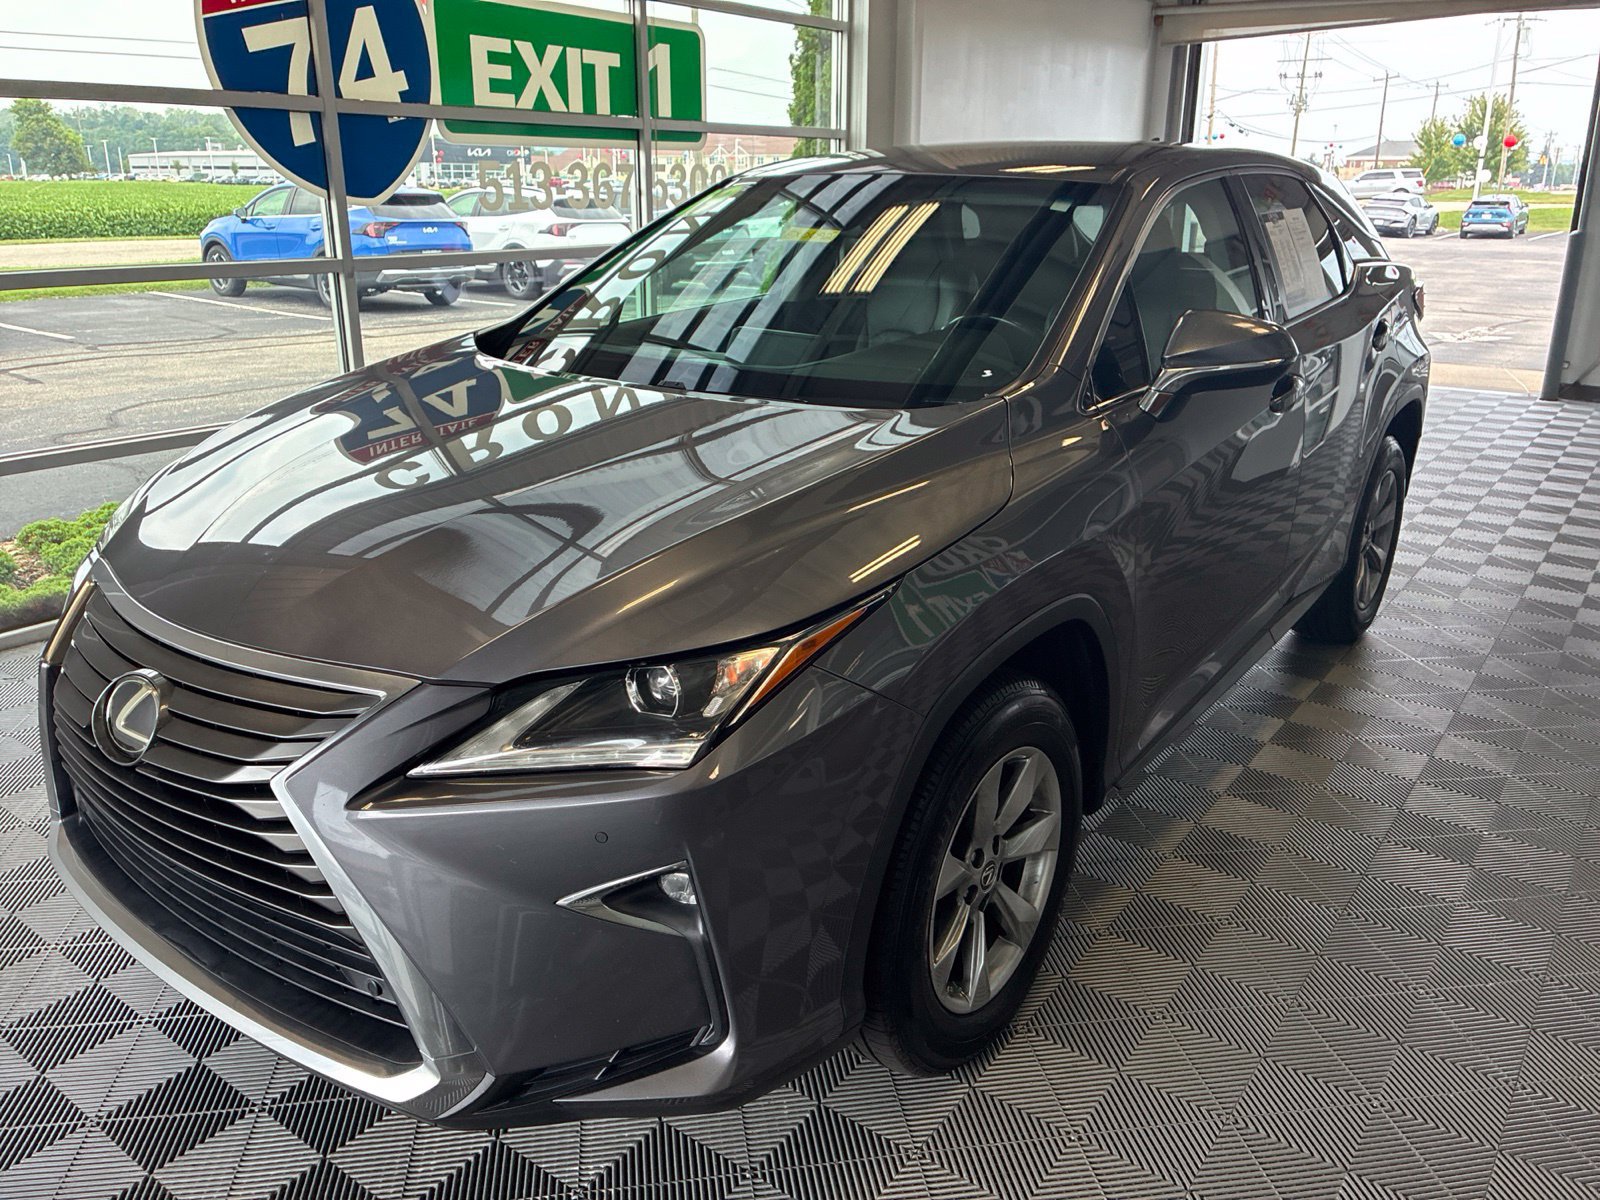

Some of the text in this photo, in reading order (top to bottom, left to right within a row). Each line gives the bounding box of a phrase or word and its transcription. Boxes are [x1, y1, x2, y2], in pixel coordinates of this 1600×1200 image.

[241, 5, 409, 147] 74
[469, 34, 672, 118] EXIT 1
[478, 160, 729, 211] 513-367530
